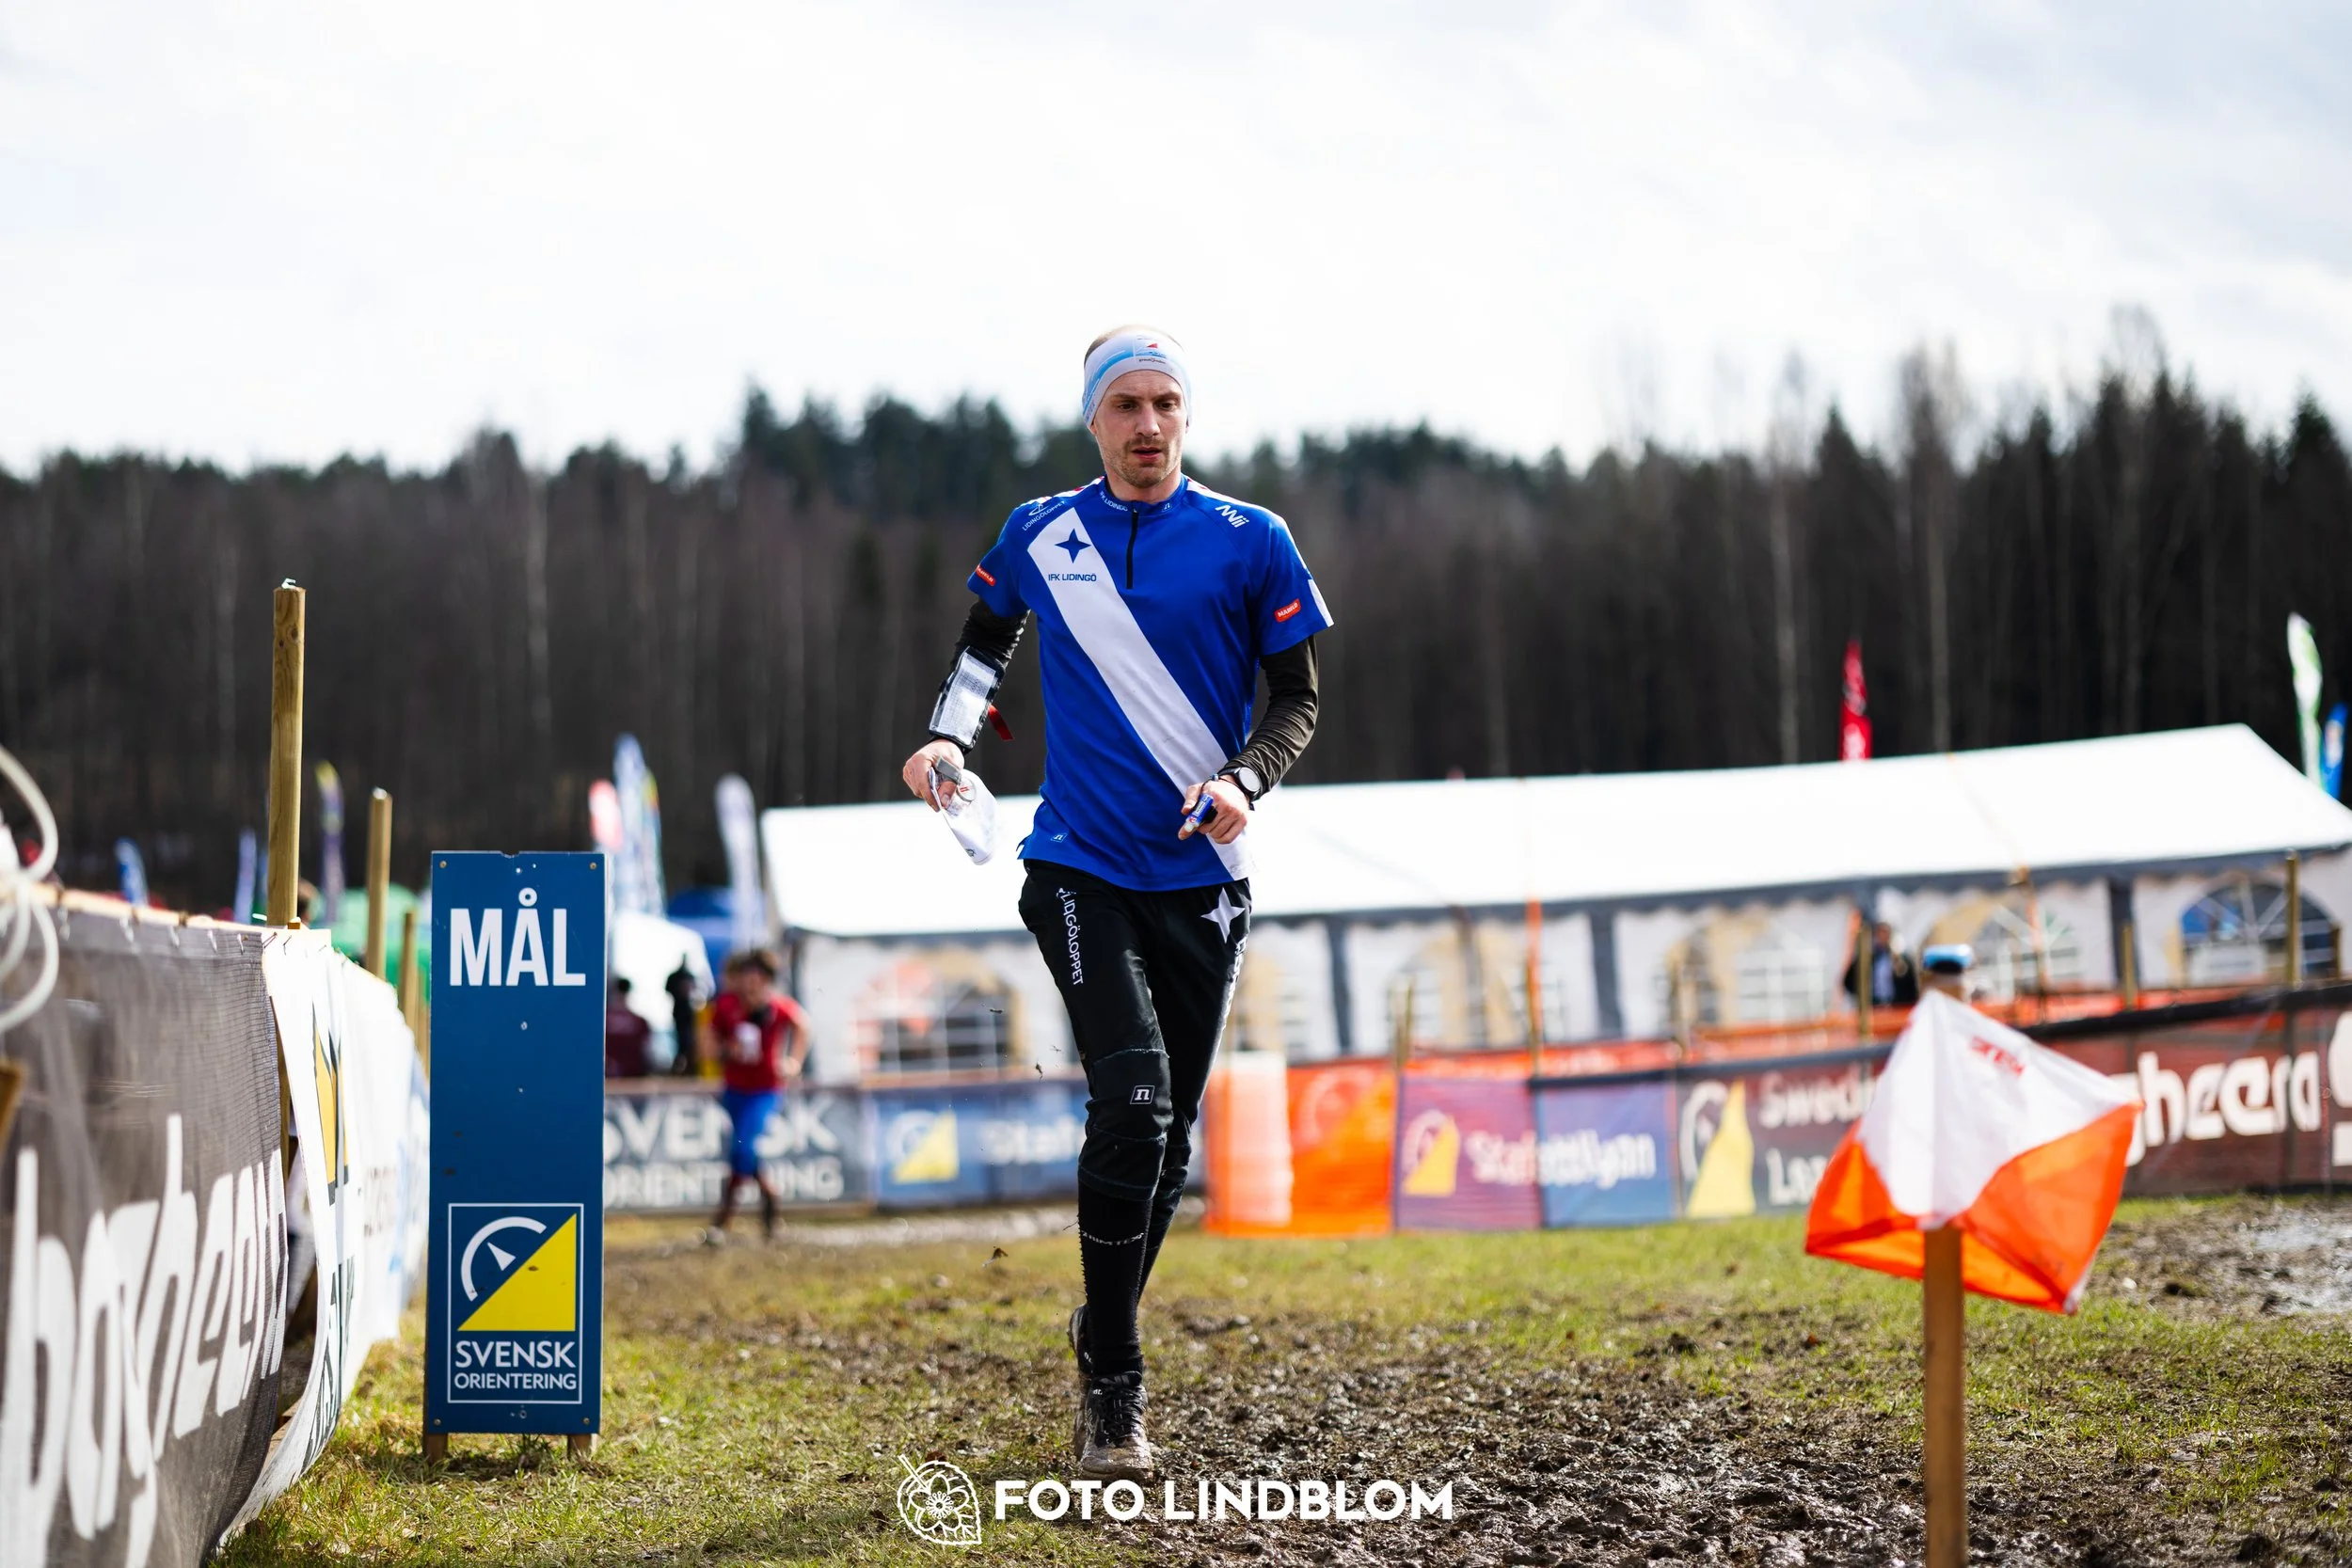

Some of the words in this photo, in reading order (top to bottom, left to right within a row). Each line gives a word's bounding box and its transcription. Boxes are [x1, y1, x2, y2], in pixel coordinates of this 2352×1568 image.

[1047, 573, 1061, 581] IFK
[1061, 572, 1097, 582] LIDINGÖ
[450, 887, 586, 986] MÅL
[454, 1339, 577, 1369] SVENSK
[453, 1372, 577, 1390] ORIENTERING
